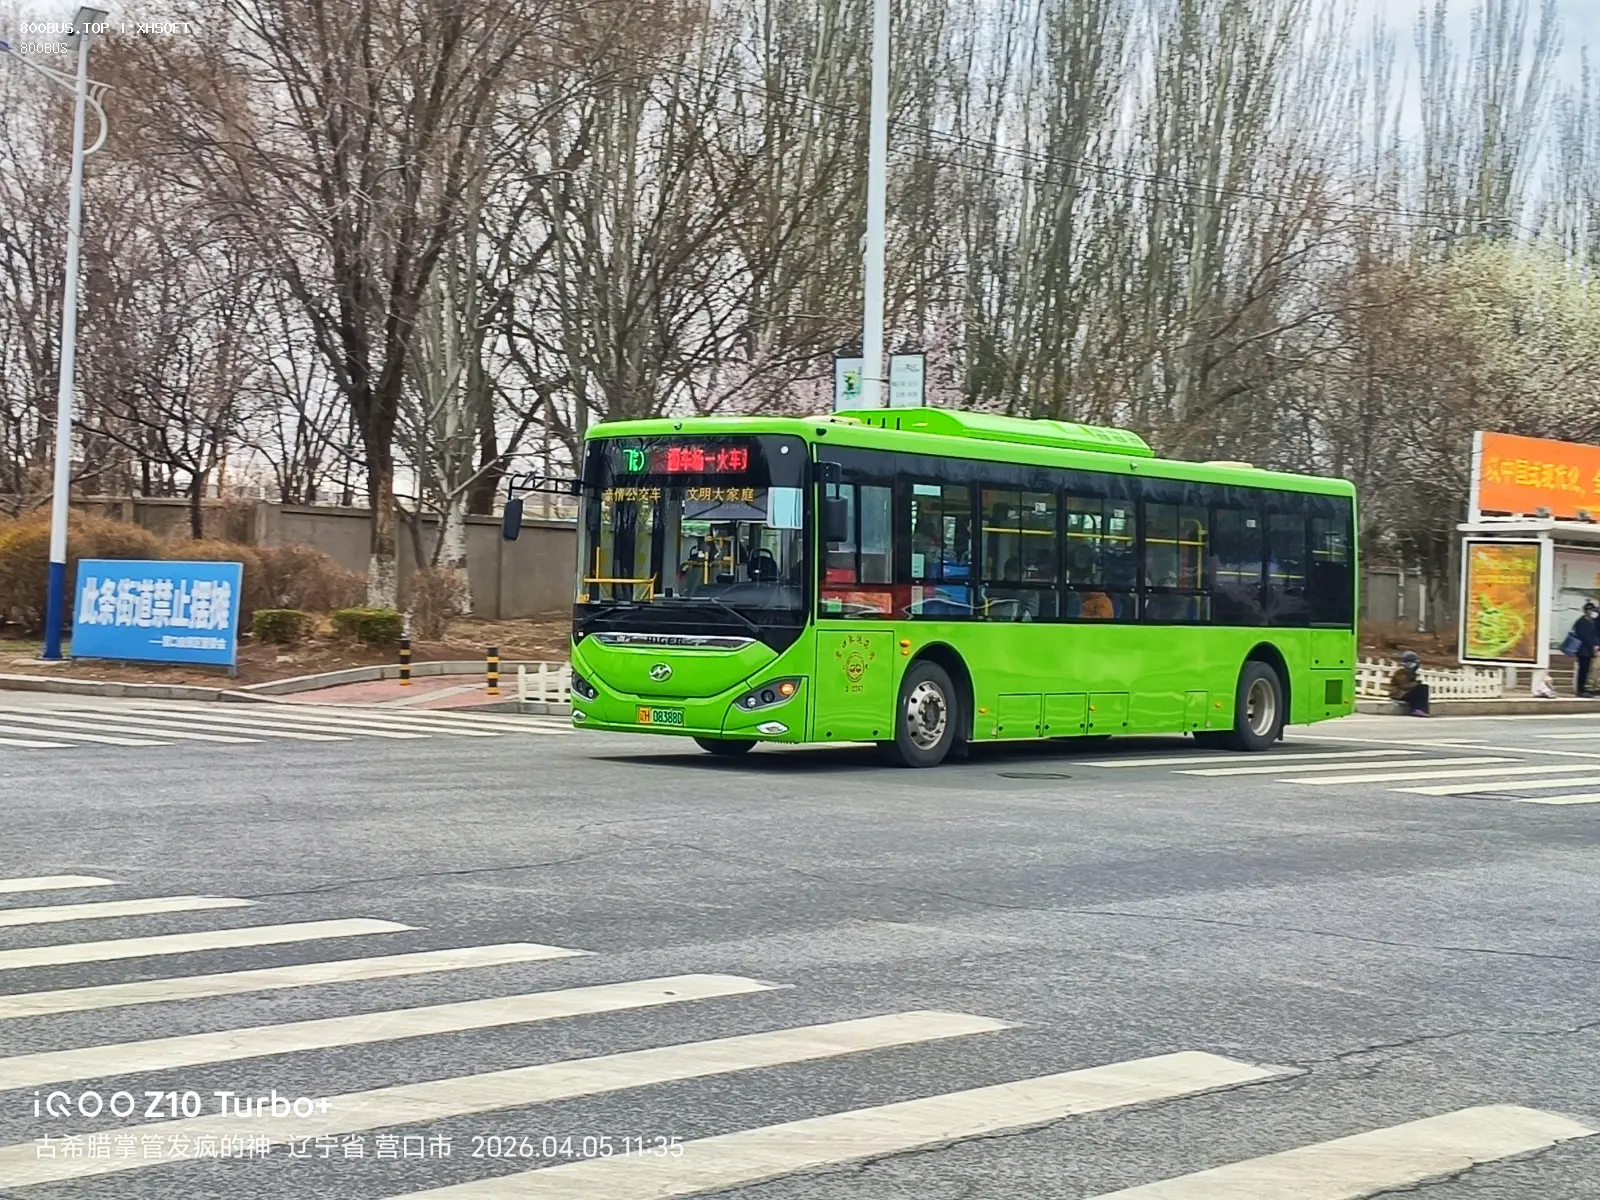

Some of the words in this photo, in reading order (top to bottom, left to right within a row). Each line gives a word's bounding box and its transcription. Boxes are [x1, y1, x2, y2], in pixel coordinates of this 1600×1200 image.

[687, 486, 756, 503] 文明大家庭
